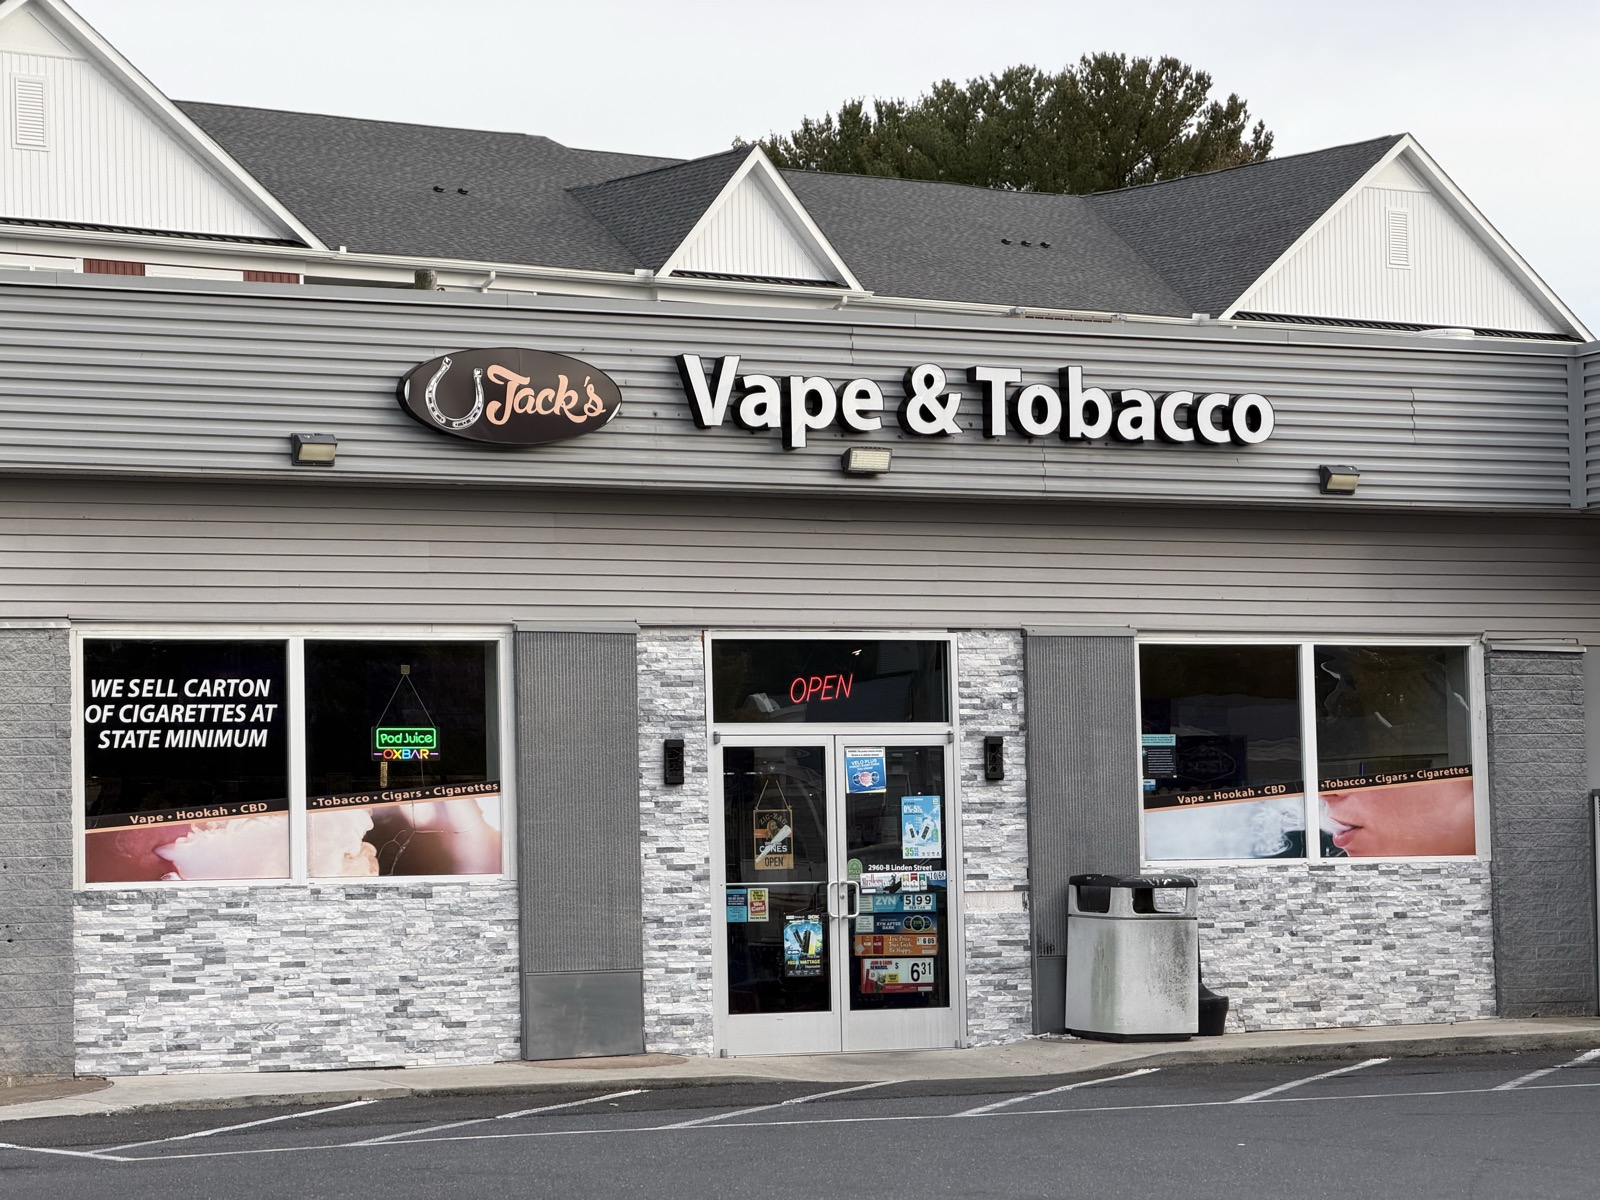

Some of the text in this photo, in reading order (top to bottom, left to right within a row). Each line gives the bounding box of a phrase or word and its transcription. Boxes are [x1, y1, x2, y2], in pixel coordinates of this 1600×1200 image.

[486, 365, 606, 425] Jack's
[680, 354, 1275, 448] Vape & Tobacco
[91, 678, 270, 698] WE SELL CARTON
[790, 673, 853, 704] OPEN
[85, 704, 278, 723] OF CIGARETTES AT
[98, 729, 268, 749] STATE MINIMUM
[380, 731, 433, 744] Pod Juice
[383, 748, 429, 760] OXBAR
[1324, 766, 1469, 789] Tobacco Cigars Cigarettes
[317, 782, 499, 807] Tobacco Cigars Cigarettes
[1177, 784, 1286, 805] Vape Hookah CBD
[129, 802, 268, 825] Vape Hookah CBD
[759, 813, 788, 826] ZIG-ZAG
[759, 845, 788, 853] CONES
[764, 857, 784, 867] OPEN
[891, 863, 913, 871] Linden
[913, 863, 932, 871] Street
[876, 896, 896, 906] ZYN
